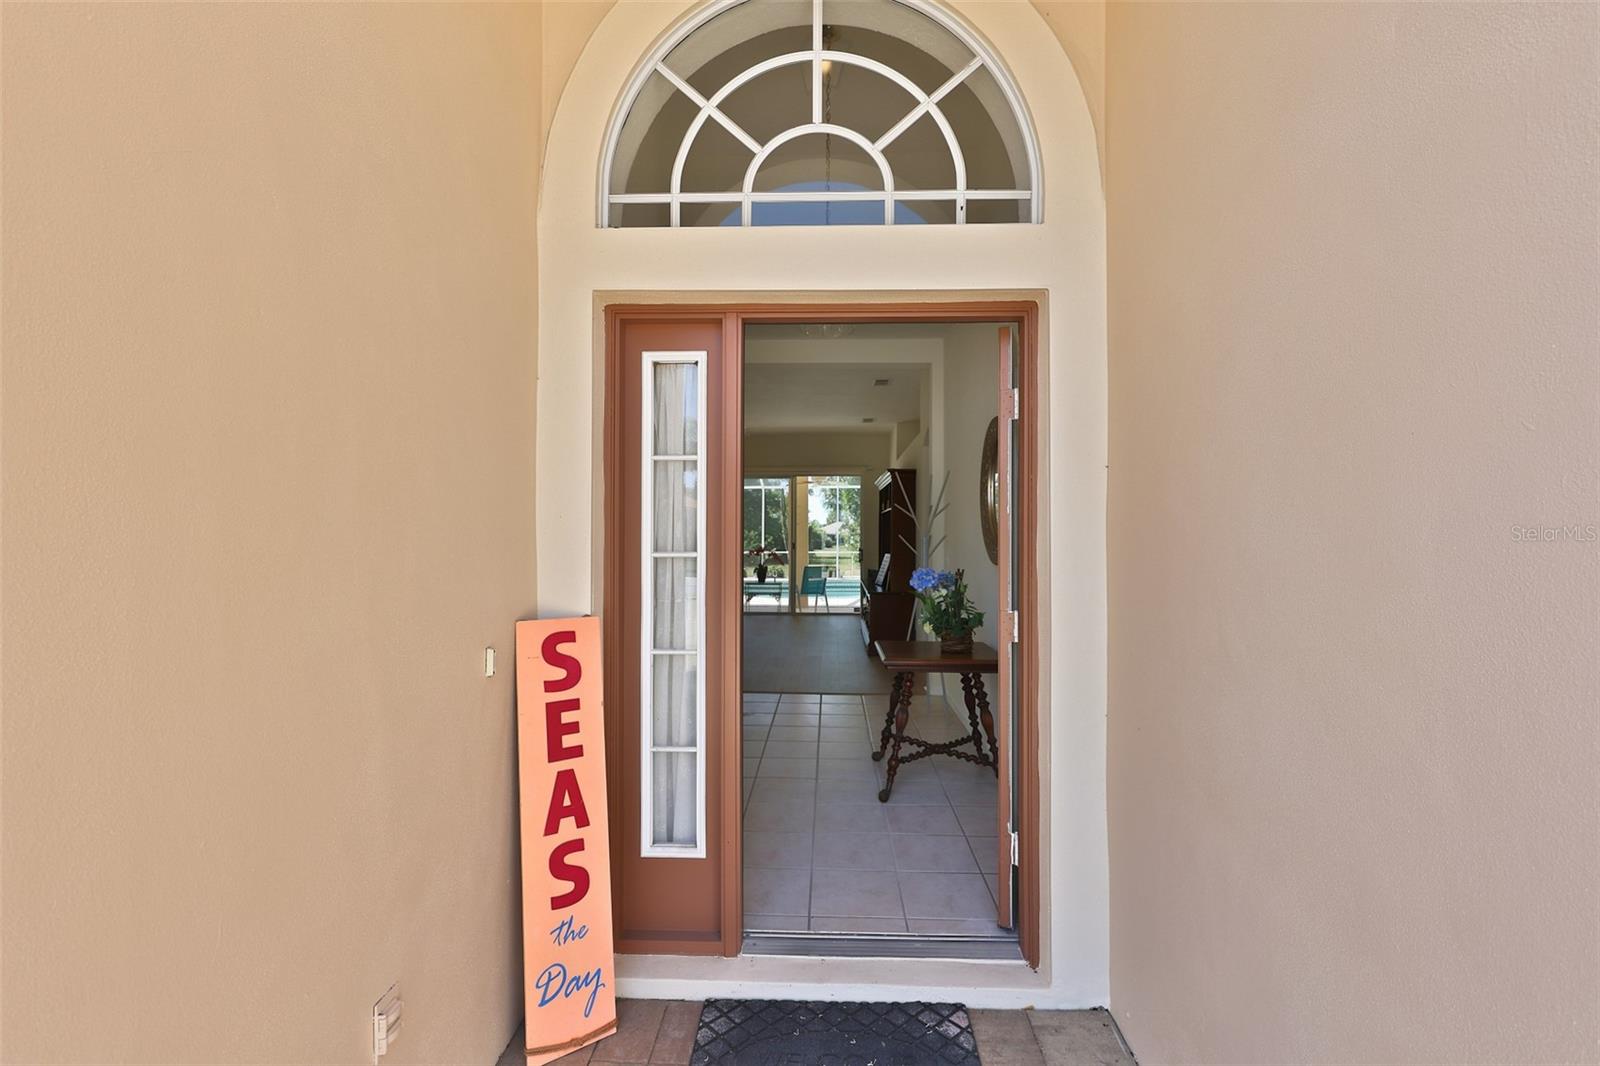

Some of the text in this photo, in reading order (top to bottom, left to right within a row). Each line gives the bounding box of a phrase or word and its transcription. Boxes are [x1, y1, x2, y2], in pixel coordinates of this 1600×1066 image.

[541, 630, 591, 911] SEAS
[550, 914, 589, 947] the
[536, 962, 605, 1018] Day
